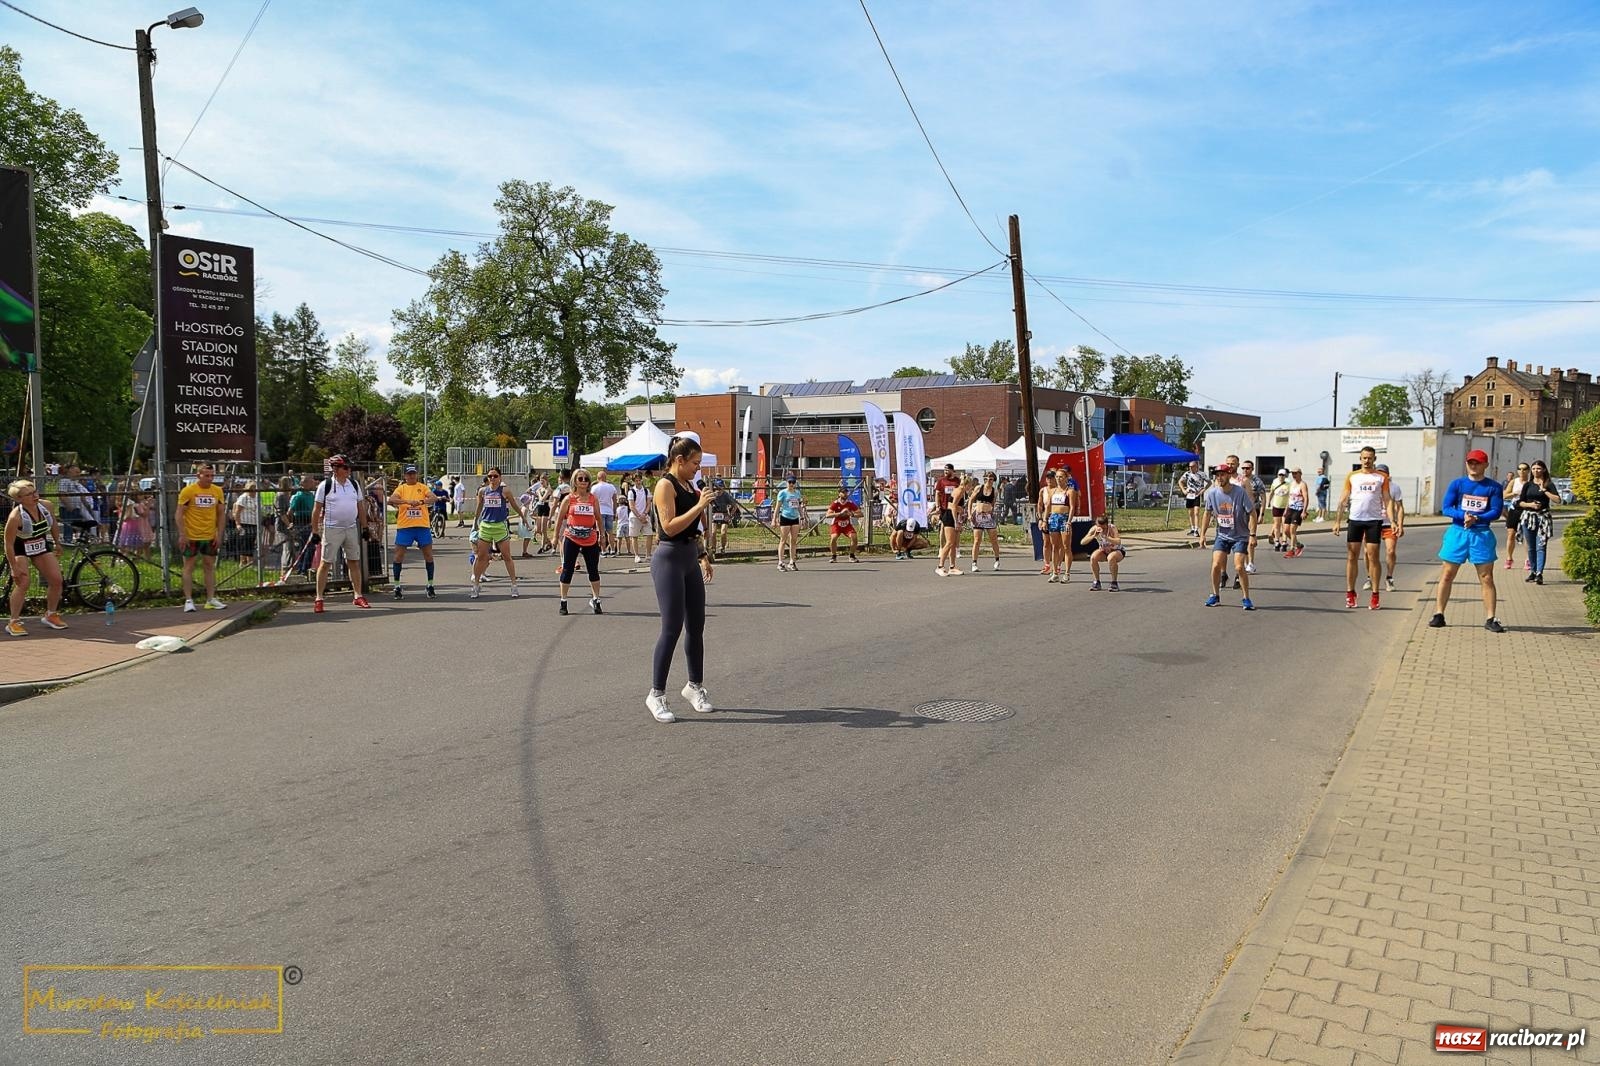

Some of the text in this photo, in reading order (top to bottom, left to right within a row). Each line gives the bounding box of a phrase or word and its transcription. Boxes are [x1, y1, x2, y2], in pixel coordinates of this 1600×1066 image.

[177, 249, 238, 275] OSiR
[202, 272, 239, 283] RACIBÓRZ
[181, 340, 238, 355] STADION
[185, 353, 235, 367] MIEJSKI
[189, 372, 232, 385] KORTY
[177, 385, 244, 399] TENISOWE
[174, 403, 248, 418] KRĘGIELNIA
[176, 421, 247, 434] SKATEPARK
[180, 447, 243, 455] www.osir-raciborz.pl
[555, 438, 565, 455] P
[1466, 500, 1482, 508] 155
